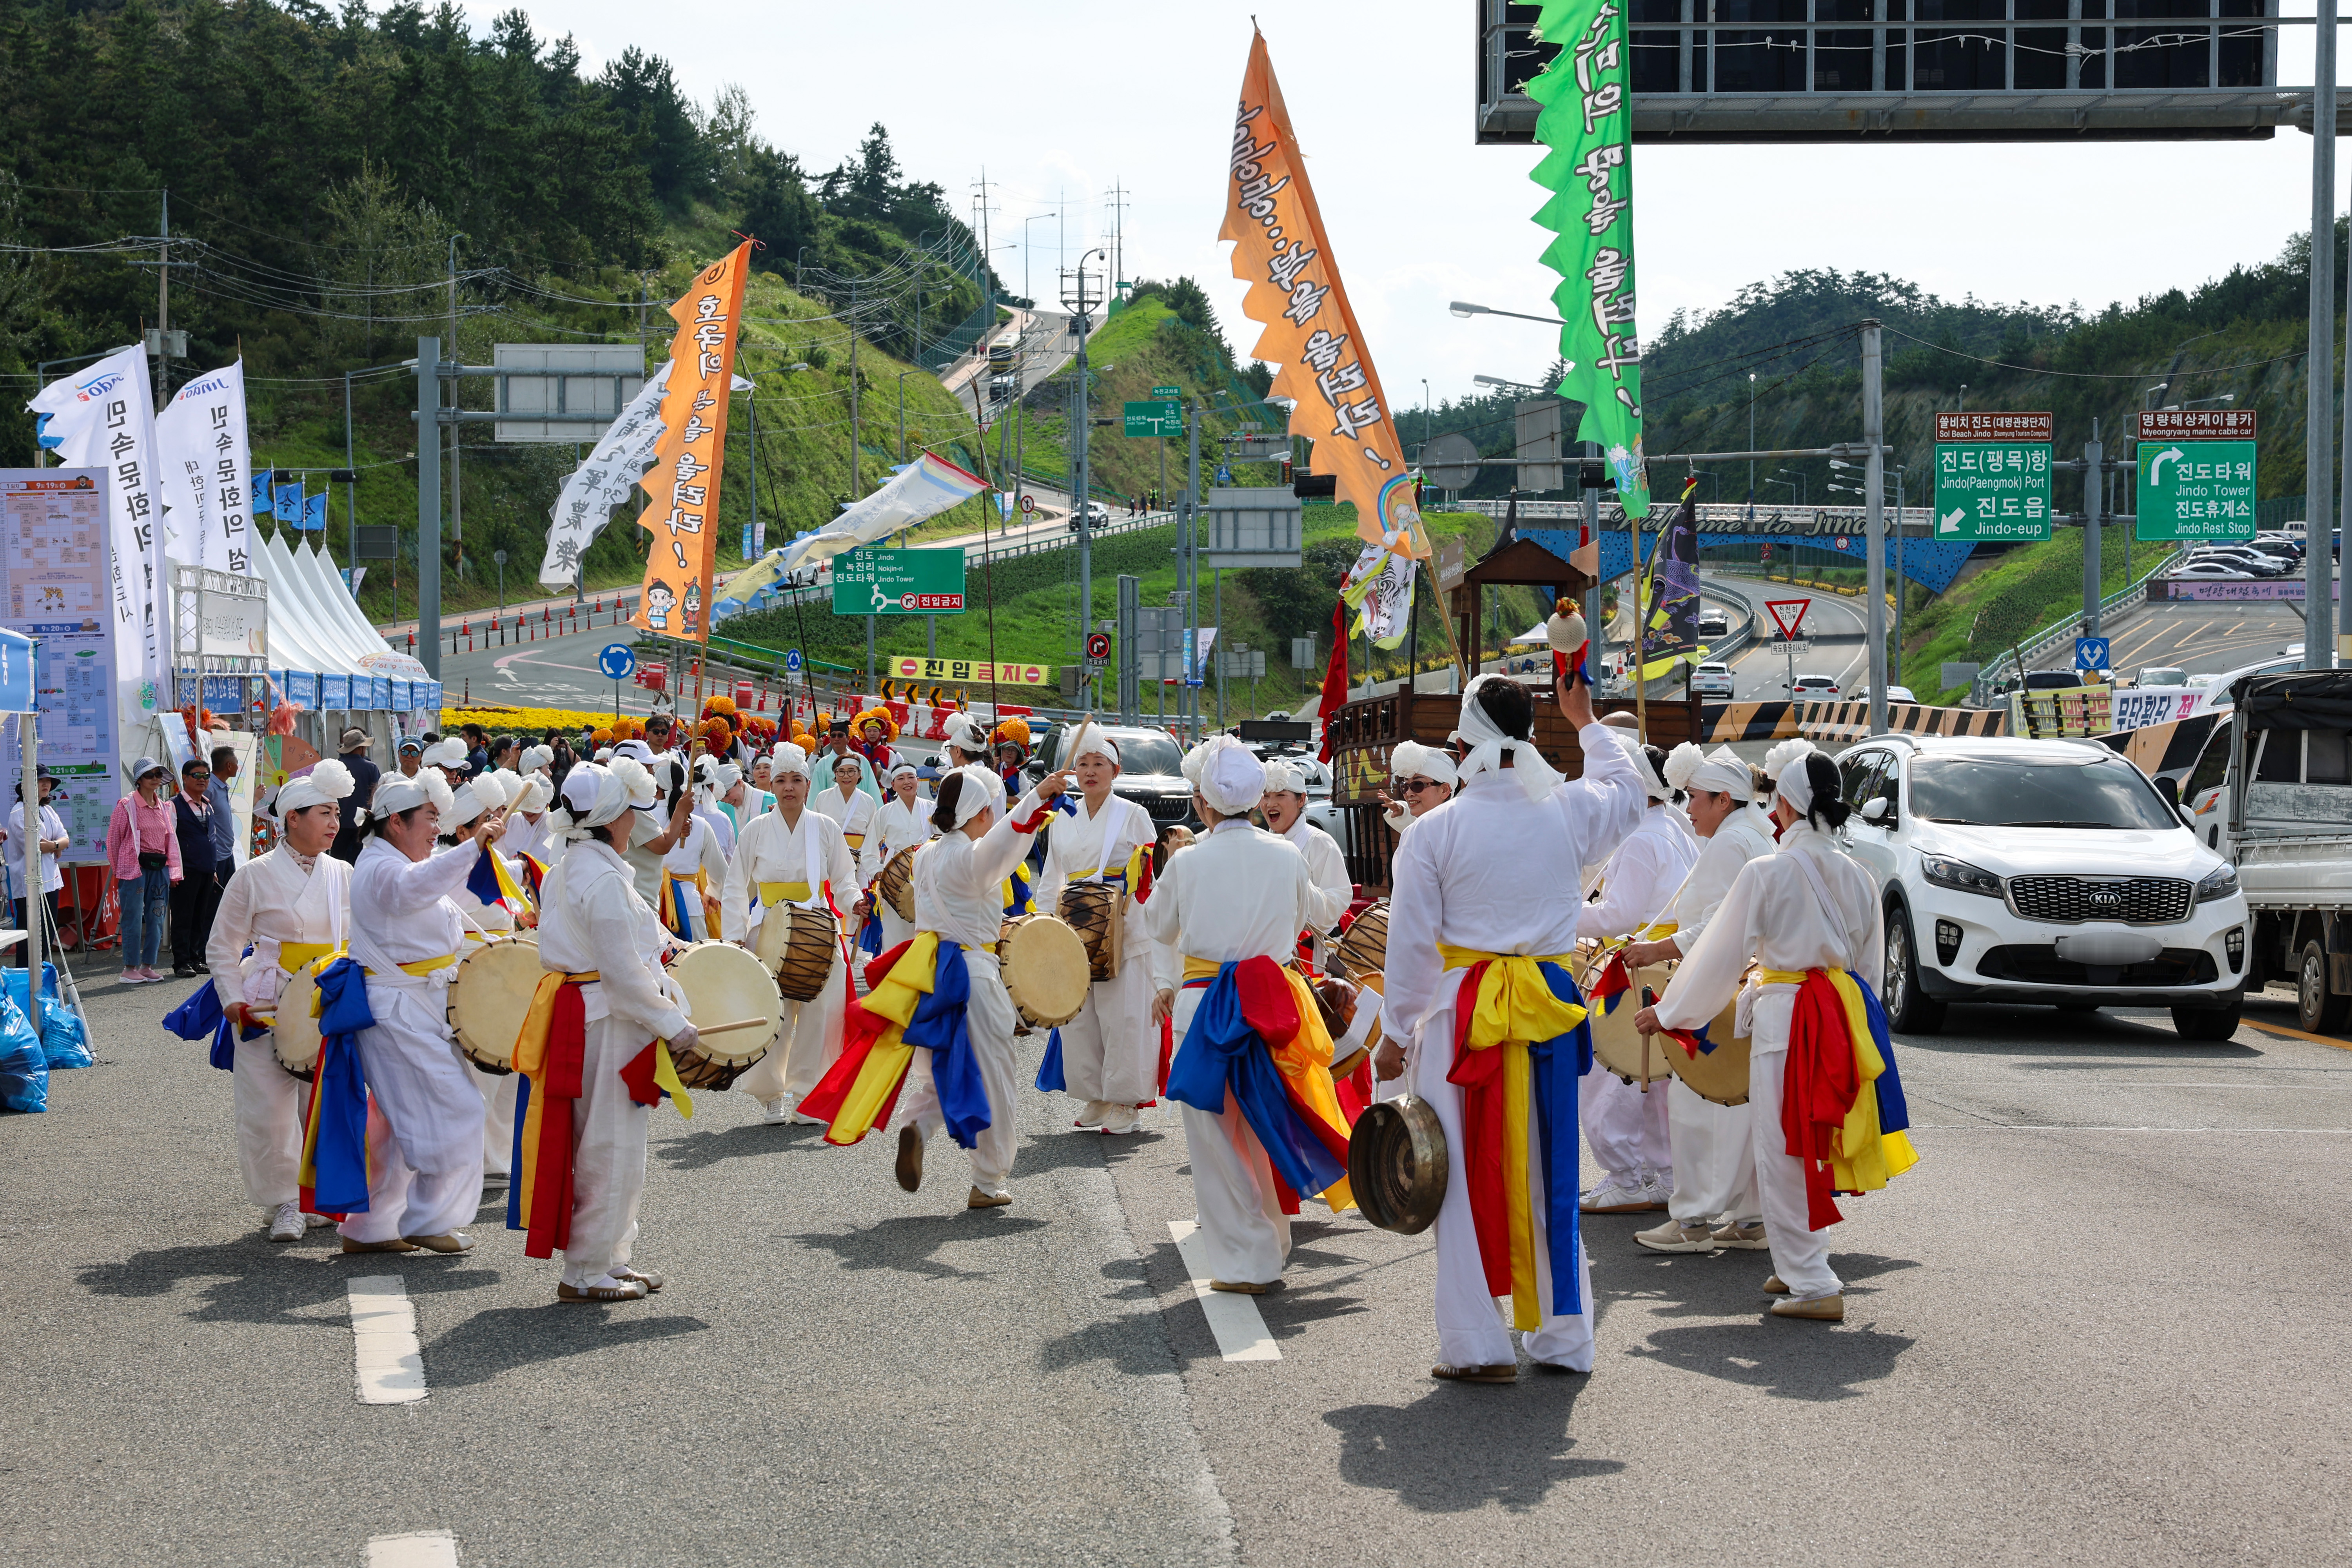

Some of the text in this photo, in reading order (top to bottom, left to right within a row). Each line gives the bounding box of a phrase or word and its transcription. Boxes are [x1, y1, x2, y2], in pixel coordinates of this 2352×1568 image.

[1939, 415, 2050, 429] 쏠비치 진도 (대명관광단지)
[2142, 412, 2252, 427] 명량해상케이블카
[2142, 428, 2190, 437] Myeongryang
[1941, 450, 2047, 474] 진도(팽목)항
[2176, 462, 2251, 481] 진도타워
[1941, 475, 2045, 492] Jindo(Paengmok) Port
[2175, 484, 2250, 496] Jindo Tower
[1976, 496, 2045, 518] 진도읍
[2175, 499, 2250, 519] 진도휴게소
[1609, 505, 1744, 534] Welme
[1764, 512, 1793, 534] to
[1975, 522, 2042, 537] Jindo-eup
[2175, 521, 2250, 536] Jindo Rest Stop
[855, 550, 874, 561] 진도
[846, 562, 875, 572] 녹진리
[836, 573, 875, 583] 진도타워
[921, 596, 960, 607] 진입금지
[1779, 604, 1798, 614] 천천히
[2094, 895, 2116, 904] KIA
